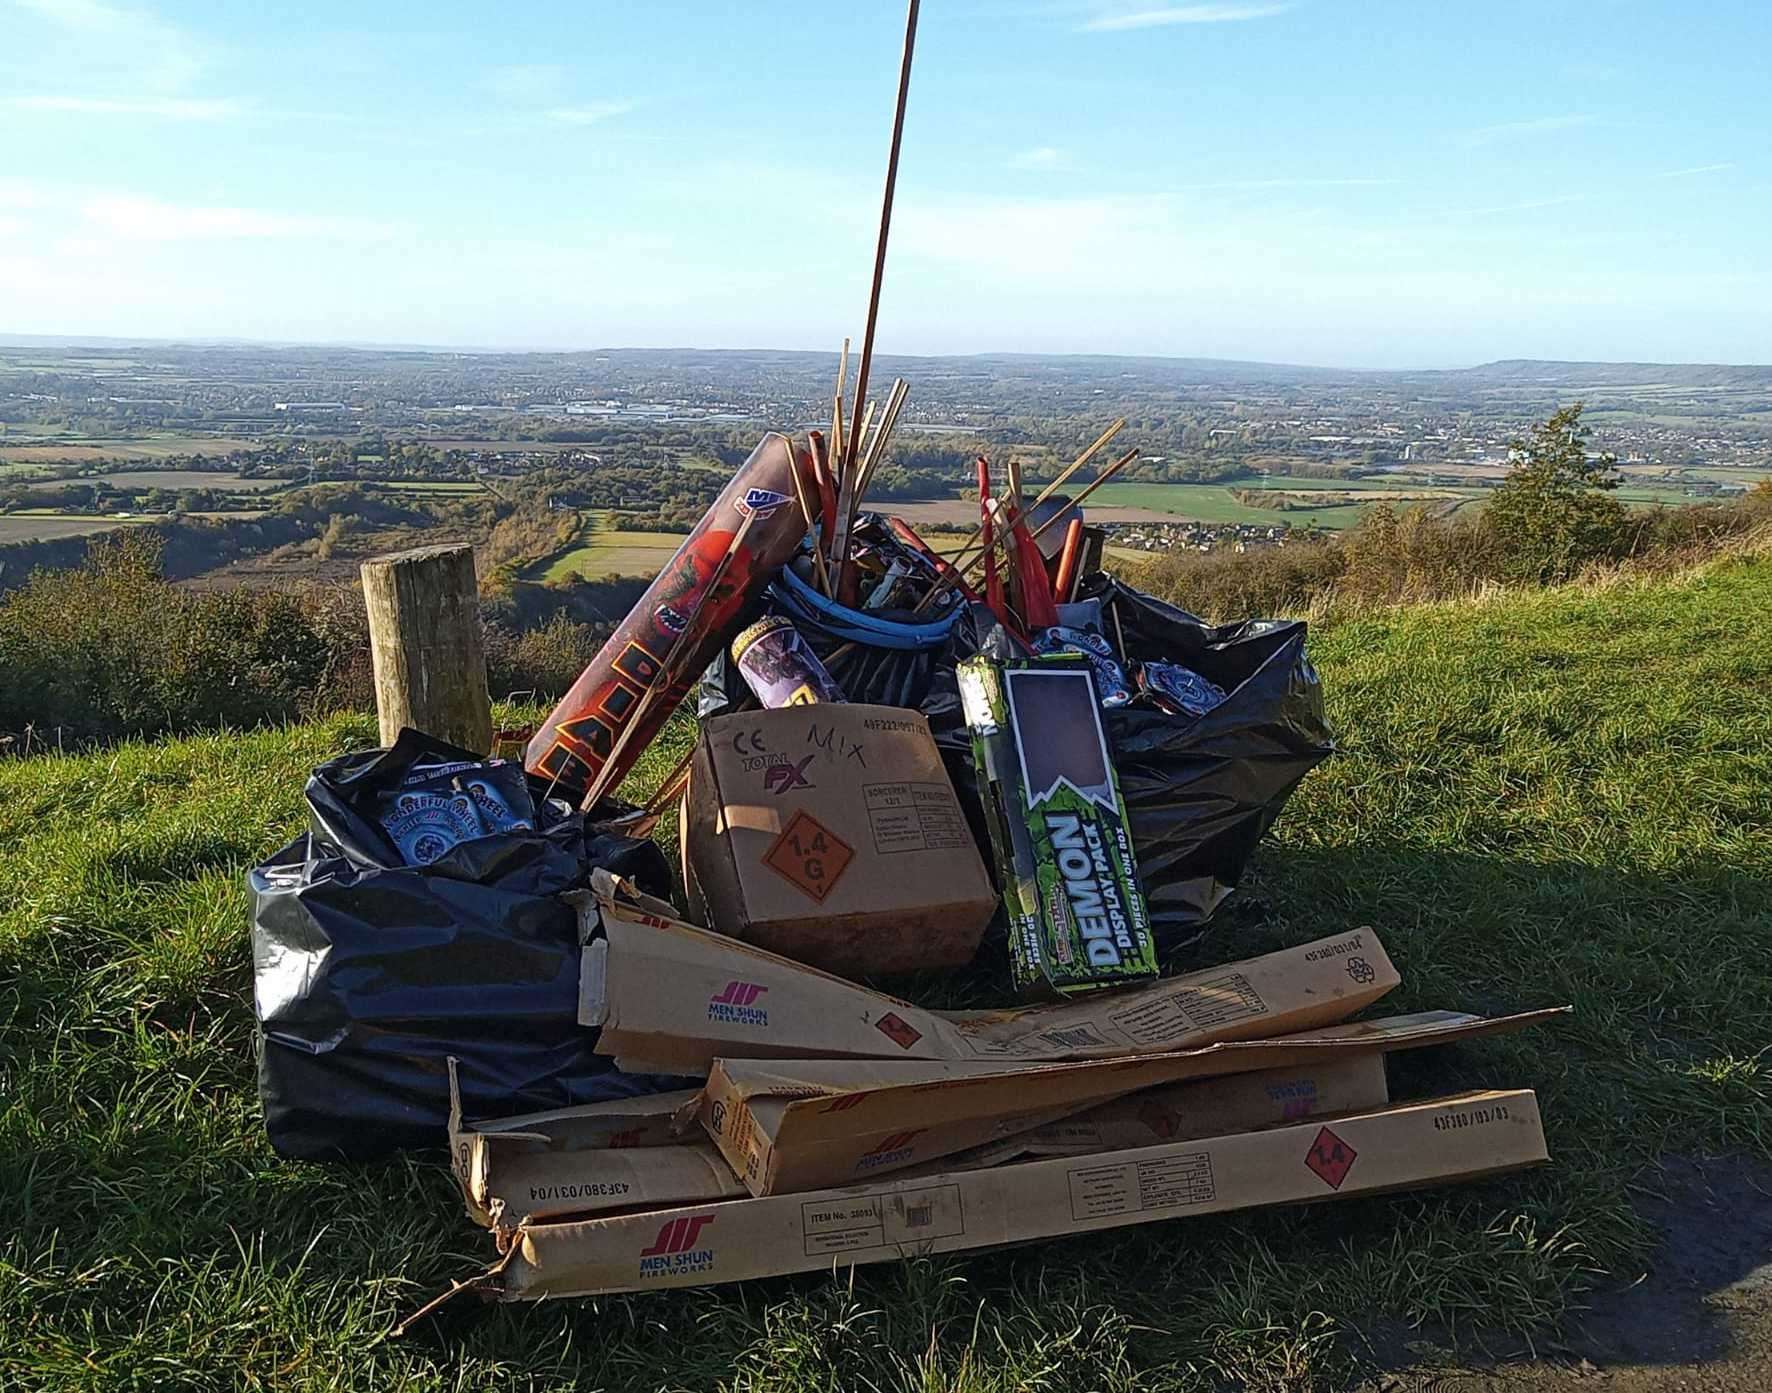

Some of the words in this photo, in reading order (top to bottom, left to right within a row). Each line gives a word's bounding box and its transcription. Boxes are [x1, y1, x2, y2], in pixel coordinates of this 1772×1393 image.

[741, 753, 790, 773] TOTAL
[763, 754, 818, 796] FX
[788, 831, 829, 858] 1.4
[1082, 823, 1110, 873] PACK
[1115, 826, 1128, 850] BOX
[804, 858, 826, 881] G
[1121, 852, 1133, 876] ONE
[1045, 813, 1123, 968] DEMON
[1128, 877, 1138, 892] IN
[1099, 878, 1132, 948] DISPLAY
[1129, 893, 1145, 929] PIECES
[707, 1014, 769, 1027] FIREWORKS
[709, 1003, 734, 1016] MEN
[736, 1006, 768, 1020] SHUN
[1313, 1143, 1347, 1165] 1.4
[529, 1182, 630, 1201] 43F380/031/04
[810, 1210, 831, 1225] ITEM
[832, 1209, 849, 1222] No.
[638, 1262, 715, 1279] FIREWORKS
[639, 1253, 671, 1271] MEN
[674, 1248, 714, 1266] SHUN
